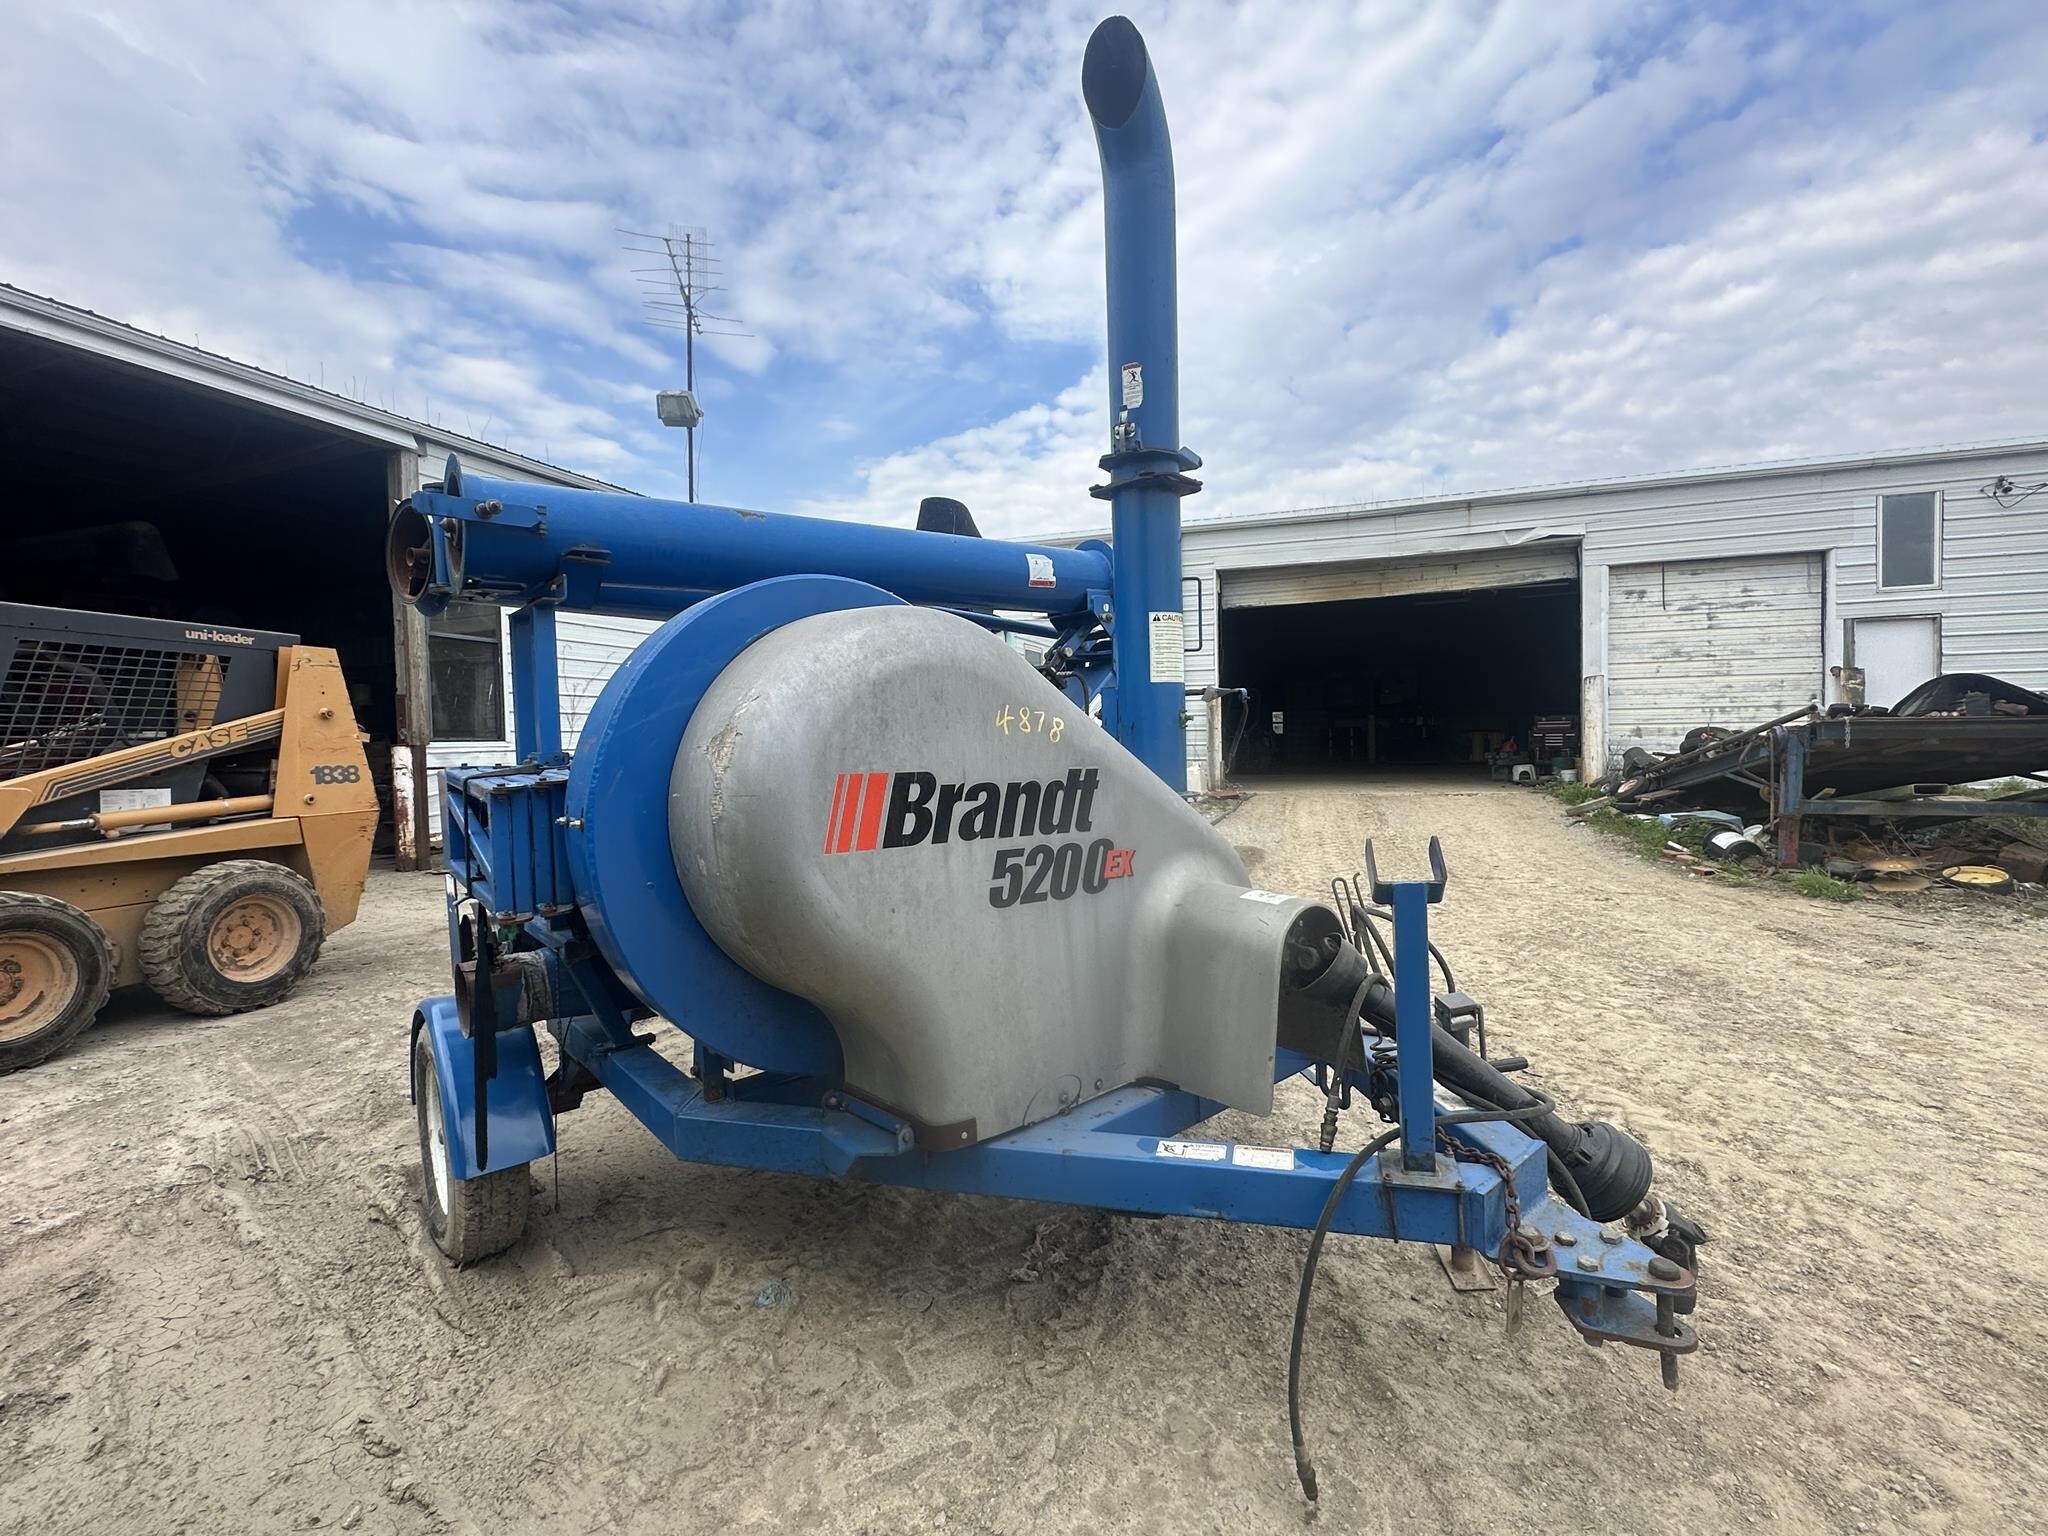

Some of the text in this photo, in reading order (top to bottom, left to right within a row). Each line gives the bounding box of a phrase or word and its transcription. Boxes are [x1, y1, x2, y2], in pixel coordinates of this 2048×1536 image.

[185, 629, 255, 645] uni-loader
[170, 723, 248, 758] CASE
[996, 704, 1065, 743] 4878
[310, 765, 361, 785] 1838
[883, 768, 1099, 849] Brandt
